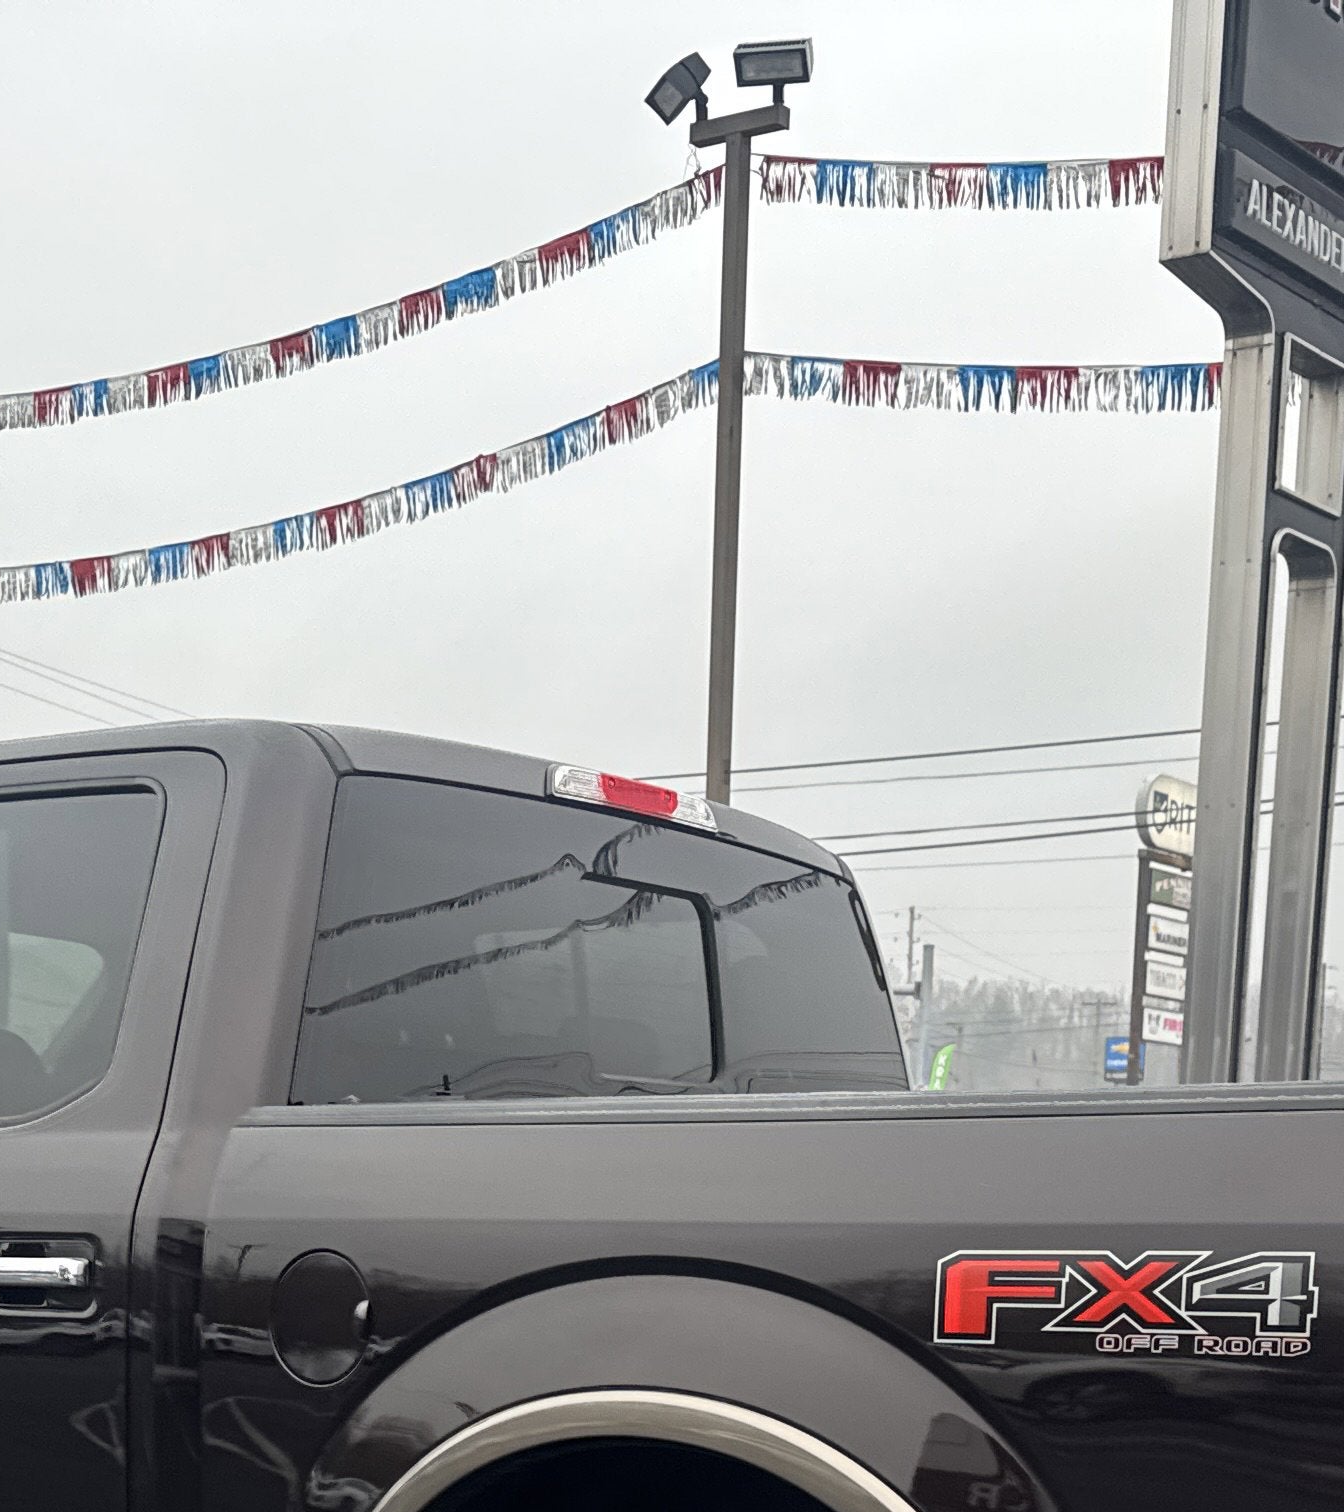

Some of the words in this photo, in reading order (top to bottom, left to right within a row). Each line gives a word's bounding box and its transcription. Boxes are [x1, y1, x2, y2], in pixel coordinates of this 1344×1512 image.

[933, 1249, 1320, 1344] FX4
[1094, 1332, 1180, 1355] OFF
[1193, 1334, 1312, 1358] ROAD
